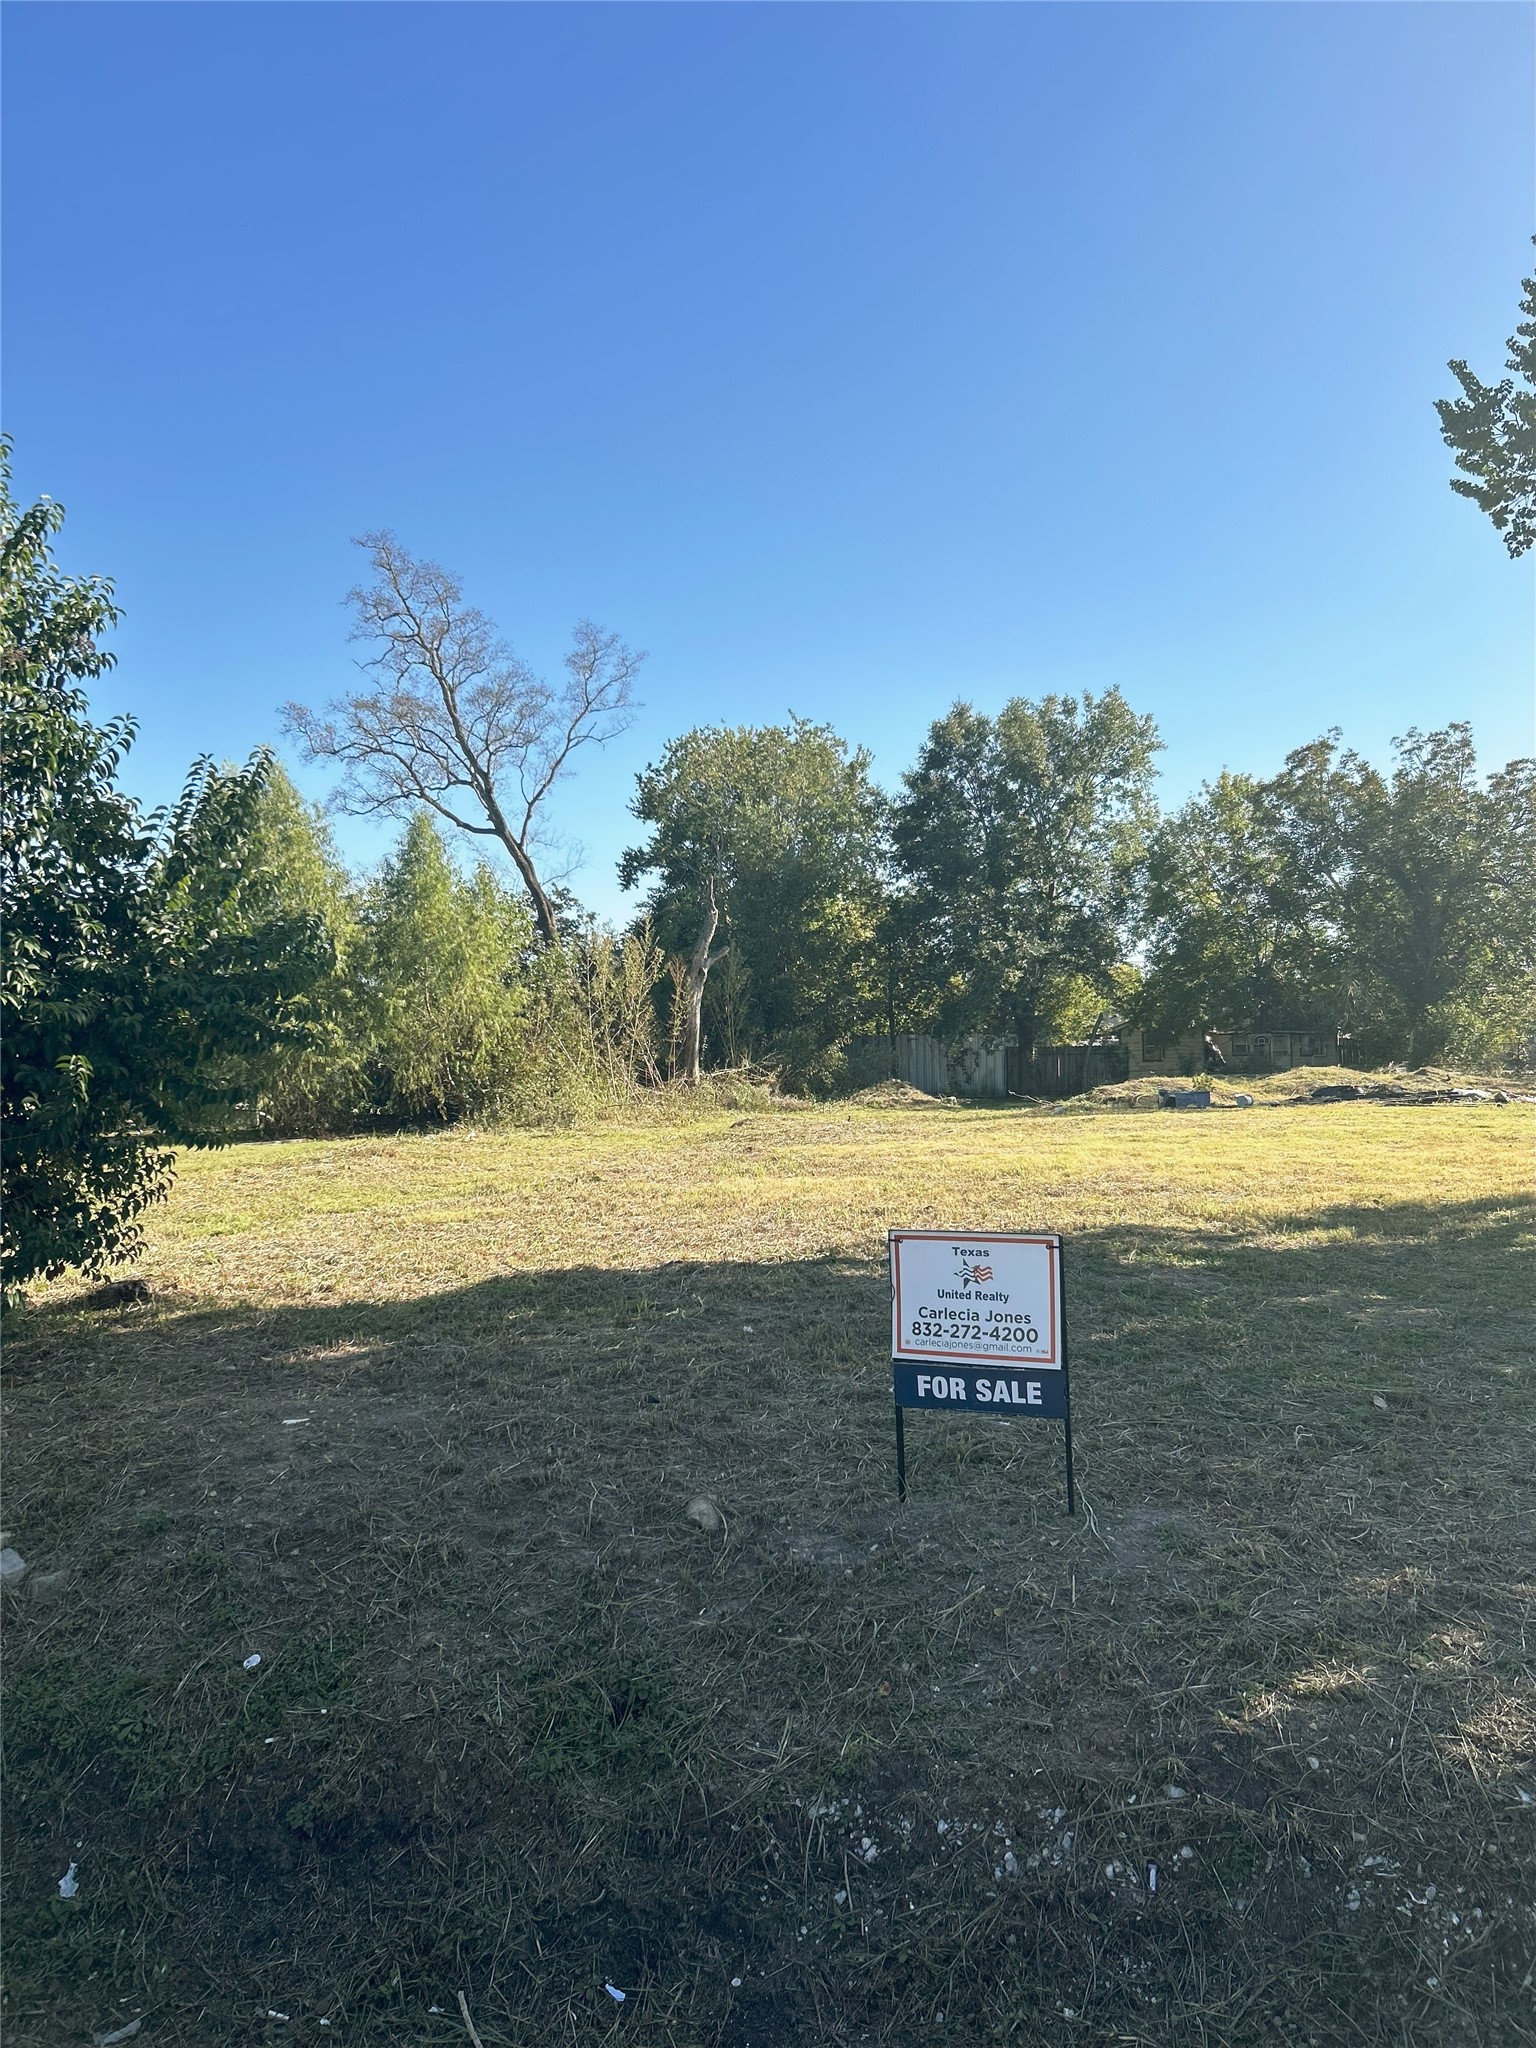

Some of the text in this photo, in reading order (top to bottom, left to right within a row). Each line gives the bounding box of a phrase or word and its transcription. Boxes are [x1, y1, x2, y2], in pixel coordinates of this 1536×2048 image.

[952, 1247, 990, 1258] Texas
[937, 1289, 1010, 1304] United Realty
[918, 1306, 1032, 1324] Carlecia Jones
[912, 1321, 1039, 1343] 832-272-4200
[914, 1338, 1032, 1353] carleciajones@gmail.com
[917, 1374, 1043, 1405] FOR SALE
